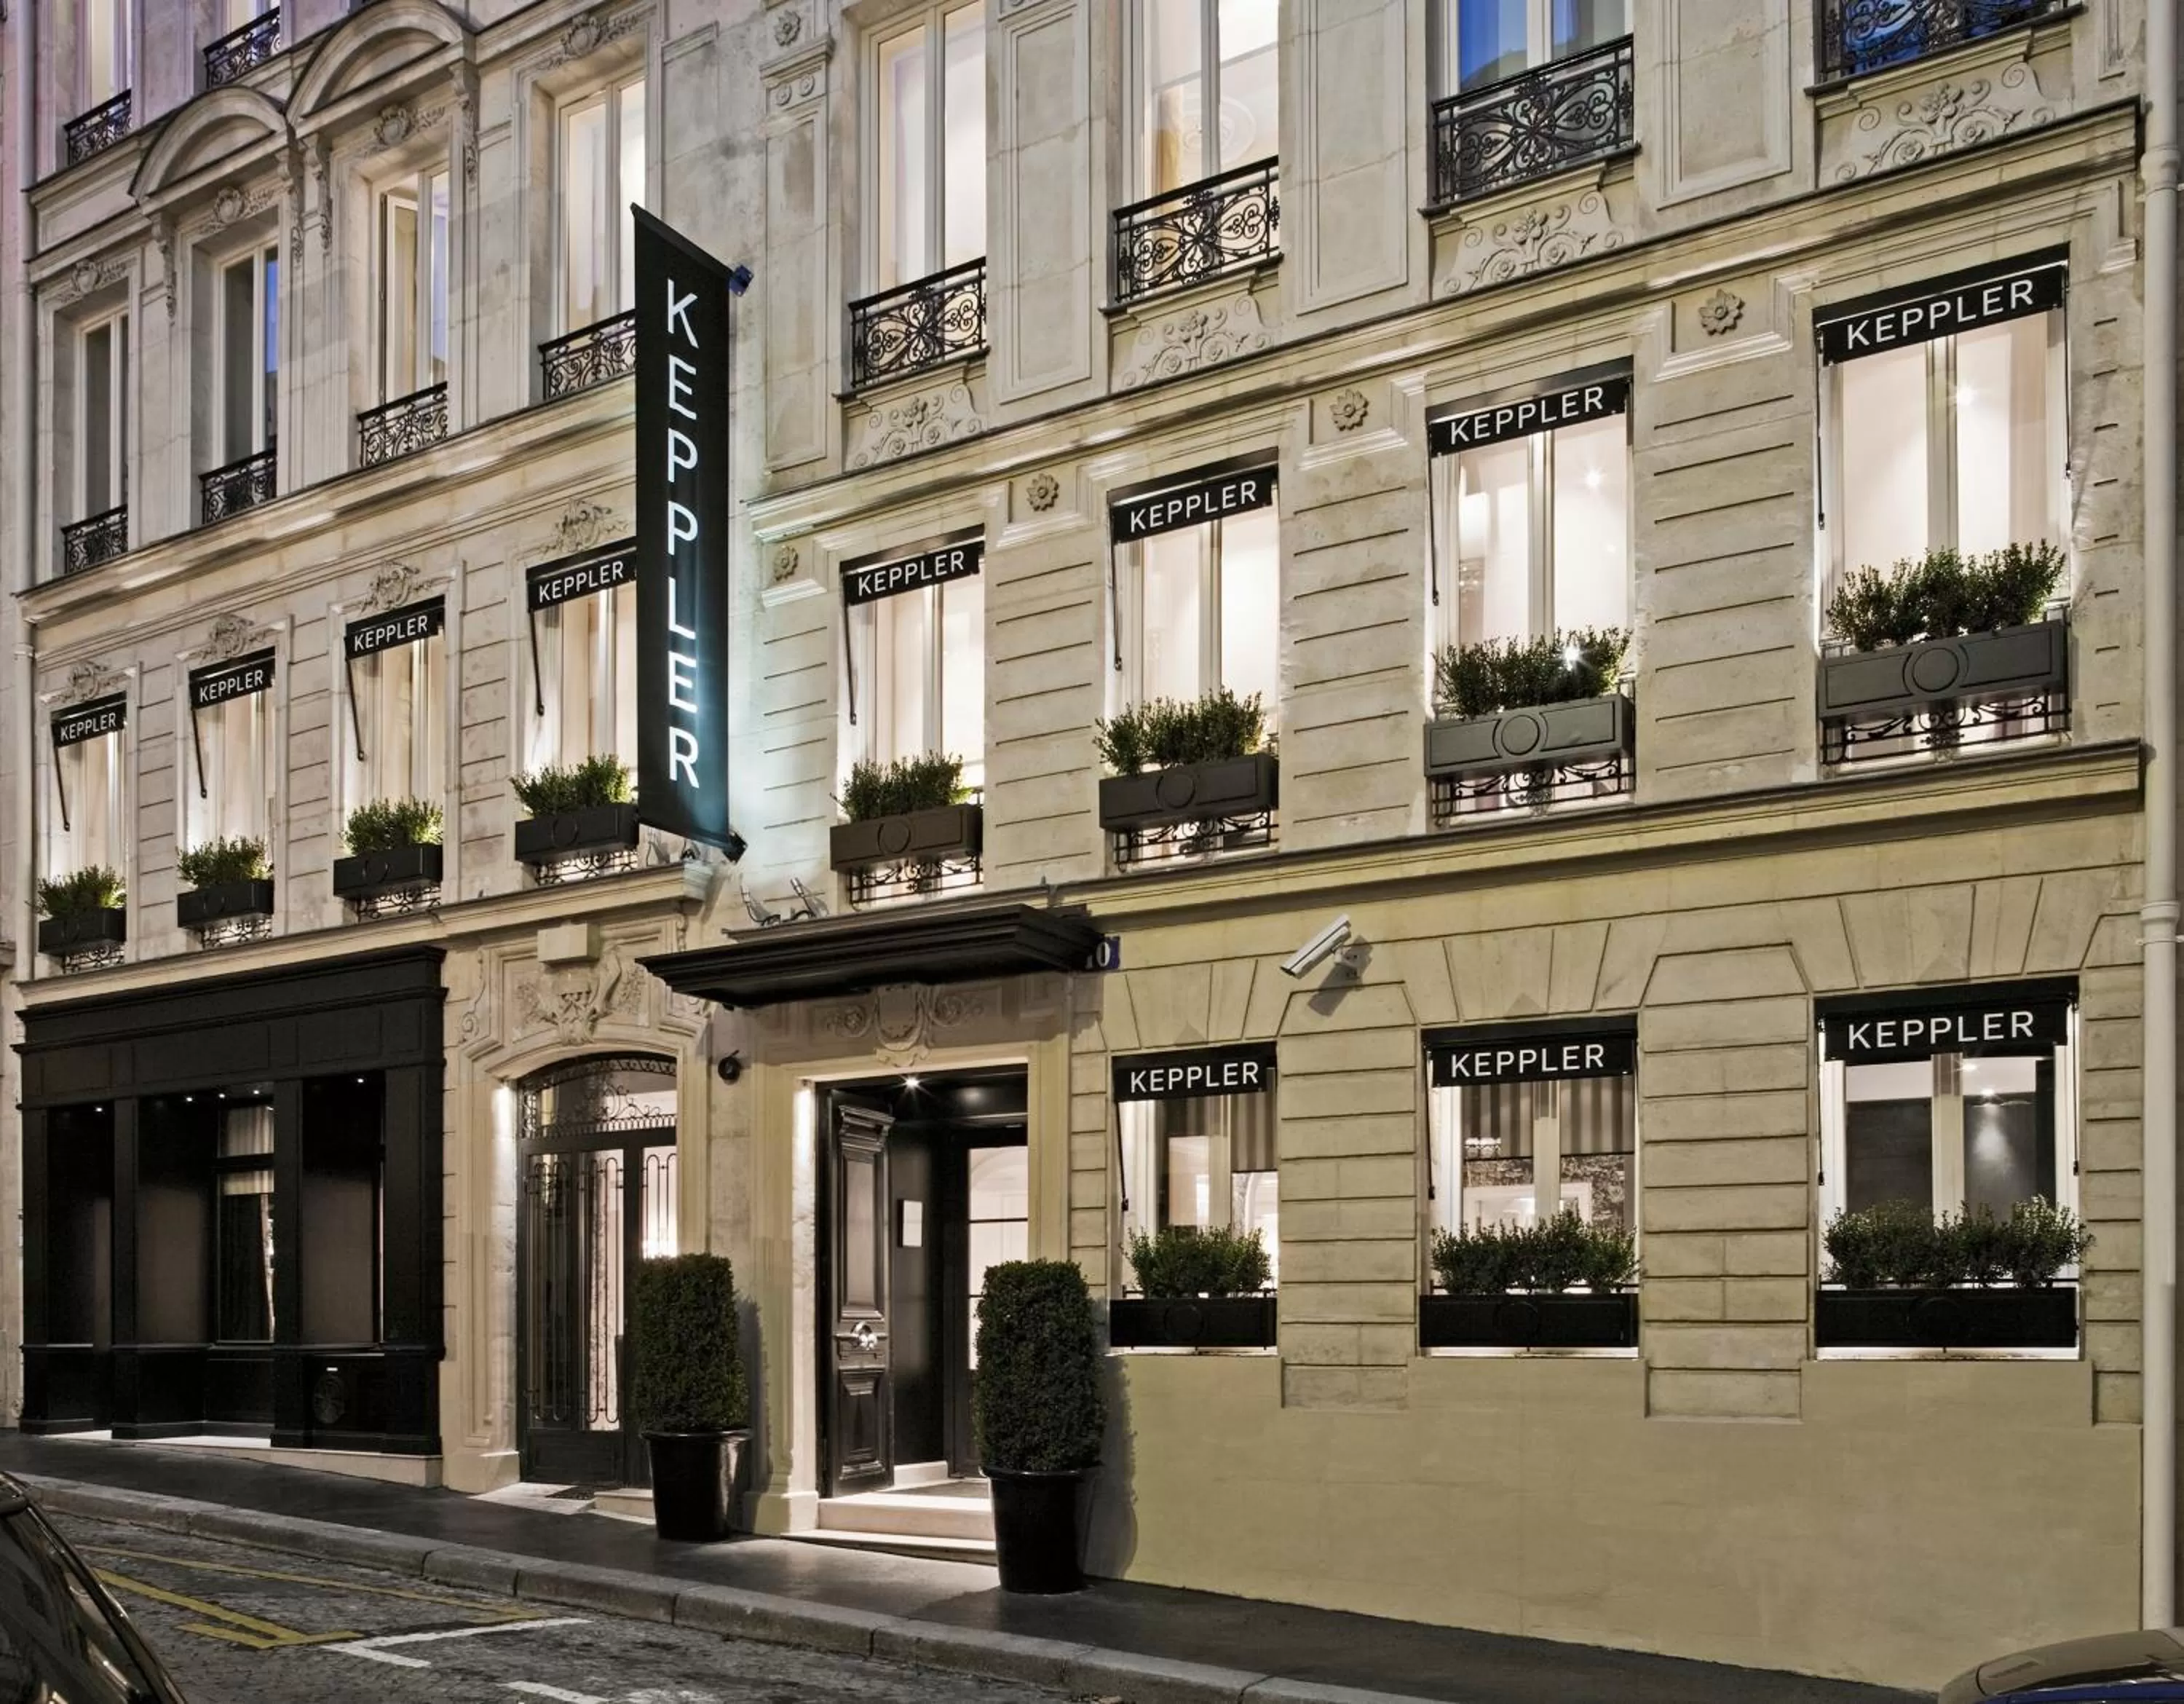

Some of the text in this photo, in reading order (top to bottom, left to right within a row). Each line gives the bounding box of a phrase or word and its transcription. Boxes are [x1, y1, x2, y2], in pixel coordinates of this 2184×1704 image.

[1848, 278, 2034, 350] KEPPLER
[1451, 386, 1604, 445] KEPPLER
[1131, 480, 1256, 533] KEPPLER
[668, 278, 700, 789] KEPPLER
[539, 560, 624, 603] KEPPLER
[858, 550, 964, 596] KEPPLER
[354, 615, 427, 651] KEPPLER
[199, 668, 264, 702] KEPPLER
[60, 711, 116, 741] KEPPLER
[1848, 1010, 2034, 1050] KEPPLER
[1131, 1060, 1259, 1093] KEPPLER
[1452, 1043, 1604, 1078] KEPPLER
